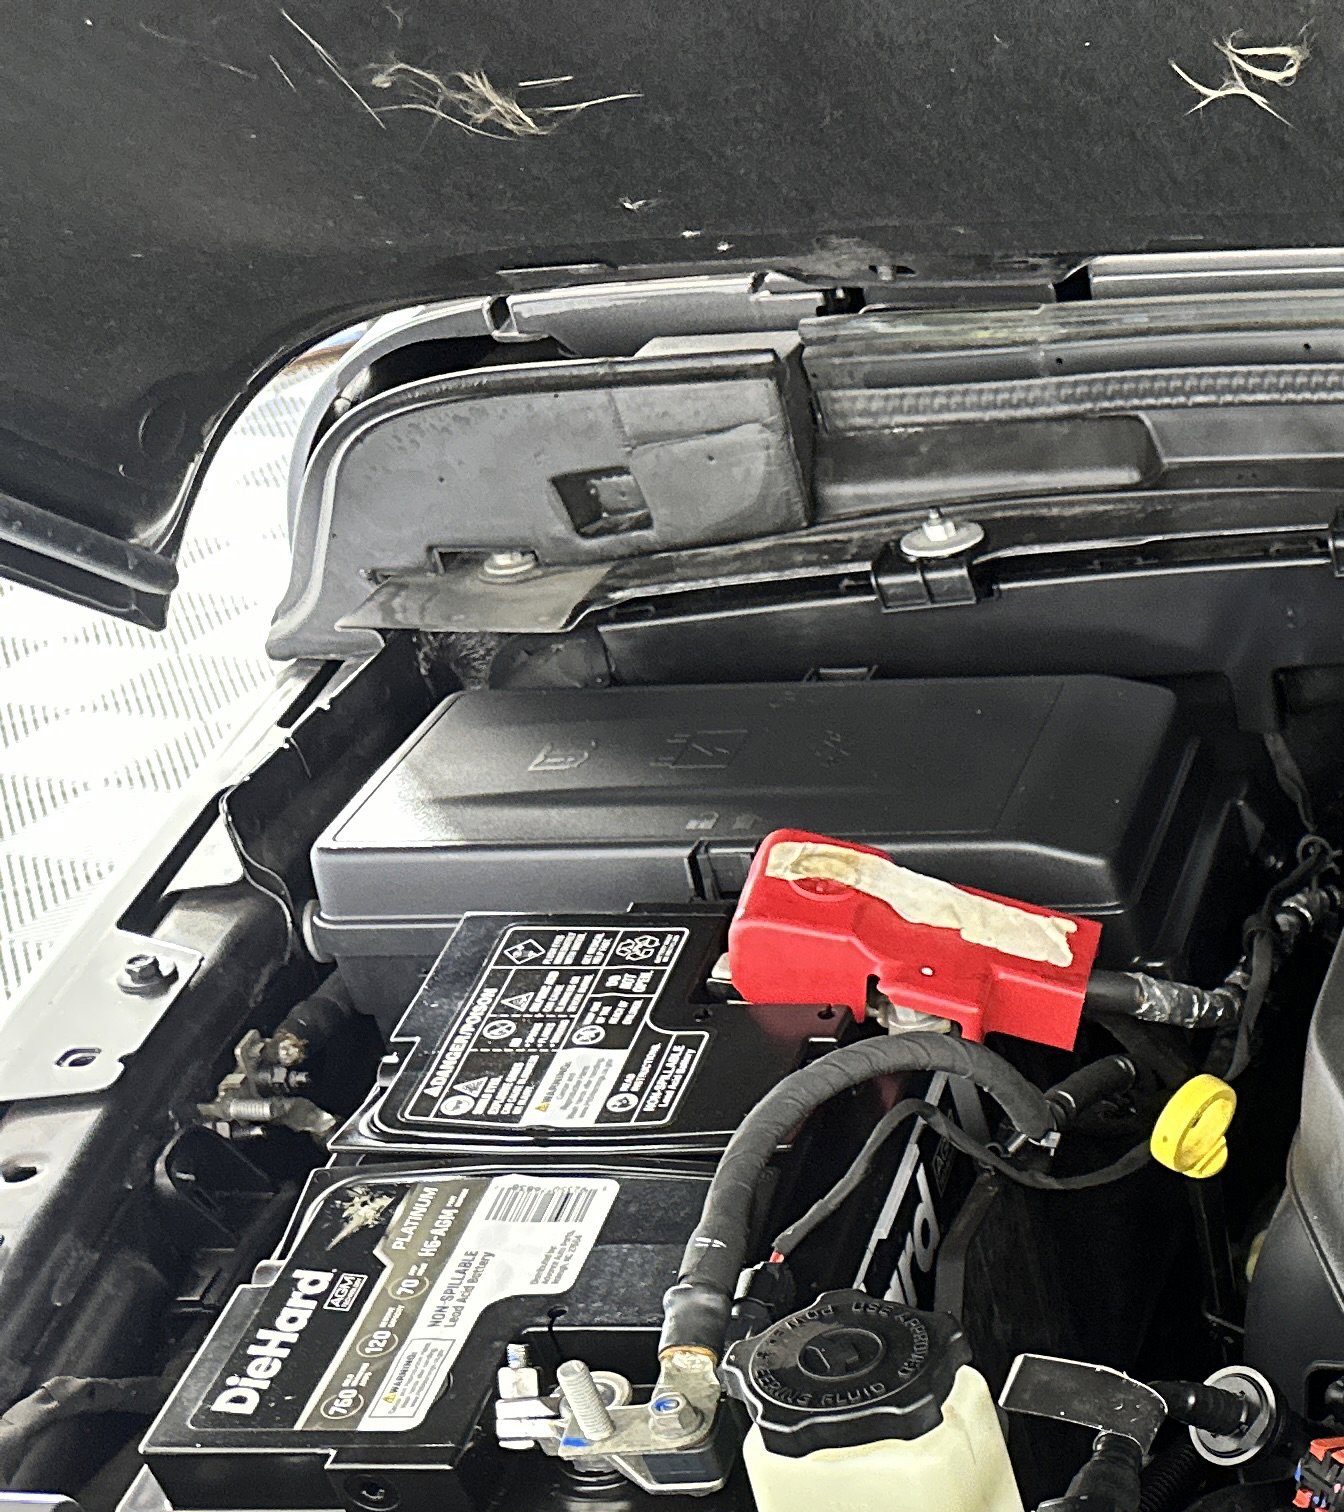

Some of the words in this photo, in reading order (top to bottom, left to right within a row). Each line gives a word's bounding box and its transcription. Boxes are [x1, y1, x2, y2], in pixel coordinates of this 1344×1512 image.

[390, 1186, 439, 1249] PLATINUM
[416, 1209, 460, 1256] H6-AGM
[329, 1276, 356, 1306] AGM
[395, 1279, 422, 1294] 70
[427, 1250, 480, 1326] NON-SPILLABLE
[443, 1303, 466, 1328] Lead
[466, 1251, 496, 1282] Battery
[209, 1268, 339, 1414] DieHard
[363, 1330, 393, 1352] 120
[820, 1381, 886, 1407] FLUID
